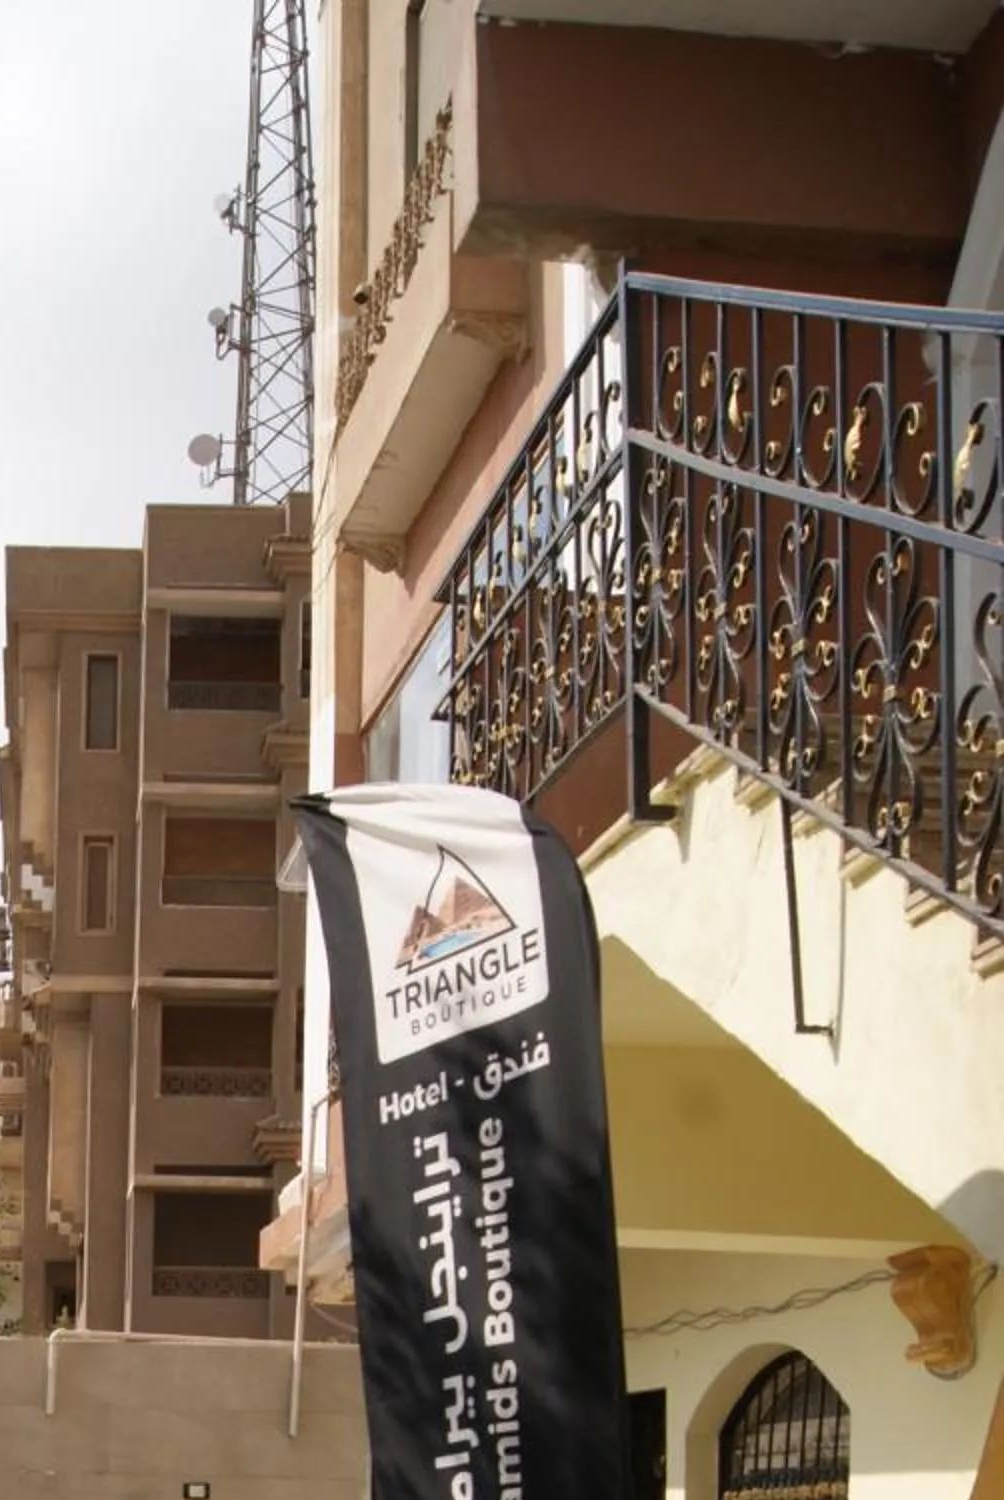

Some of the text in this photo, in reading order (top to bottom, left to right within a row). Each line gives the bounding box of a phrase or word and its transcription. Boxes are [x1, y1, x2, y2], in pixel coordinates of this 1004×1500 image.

[385, 927, 541, 1019] TRIANGLE
[410, 975, 527, 1036] BOUTIQUE
[378, 1070, 448, 1125] Hotel
[472, 1031, 551, 1100] فندق
[412, 1130, 470, 1354] تراينجل
[474, 1116, 515, 1348] Boutique
